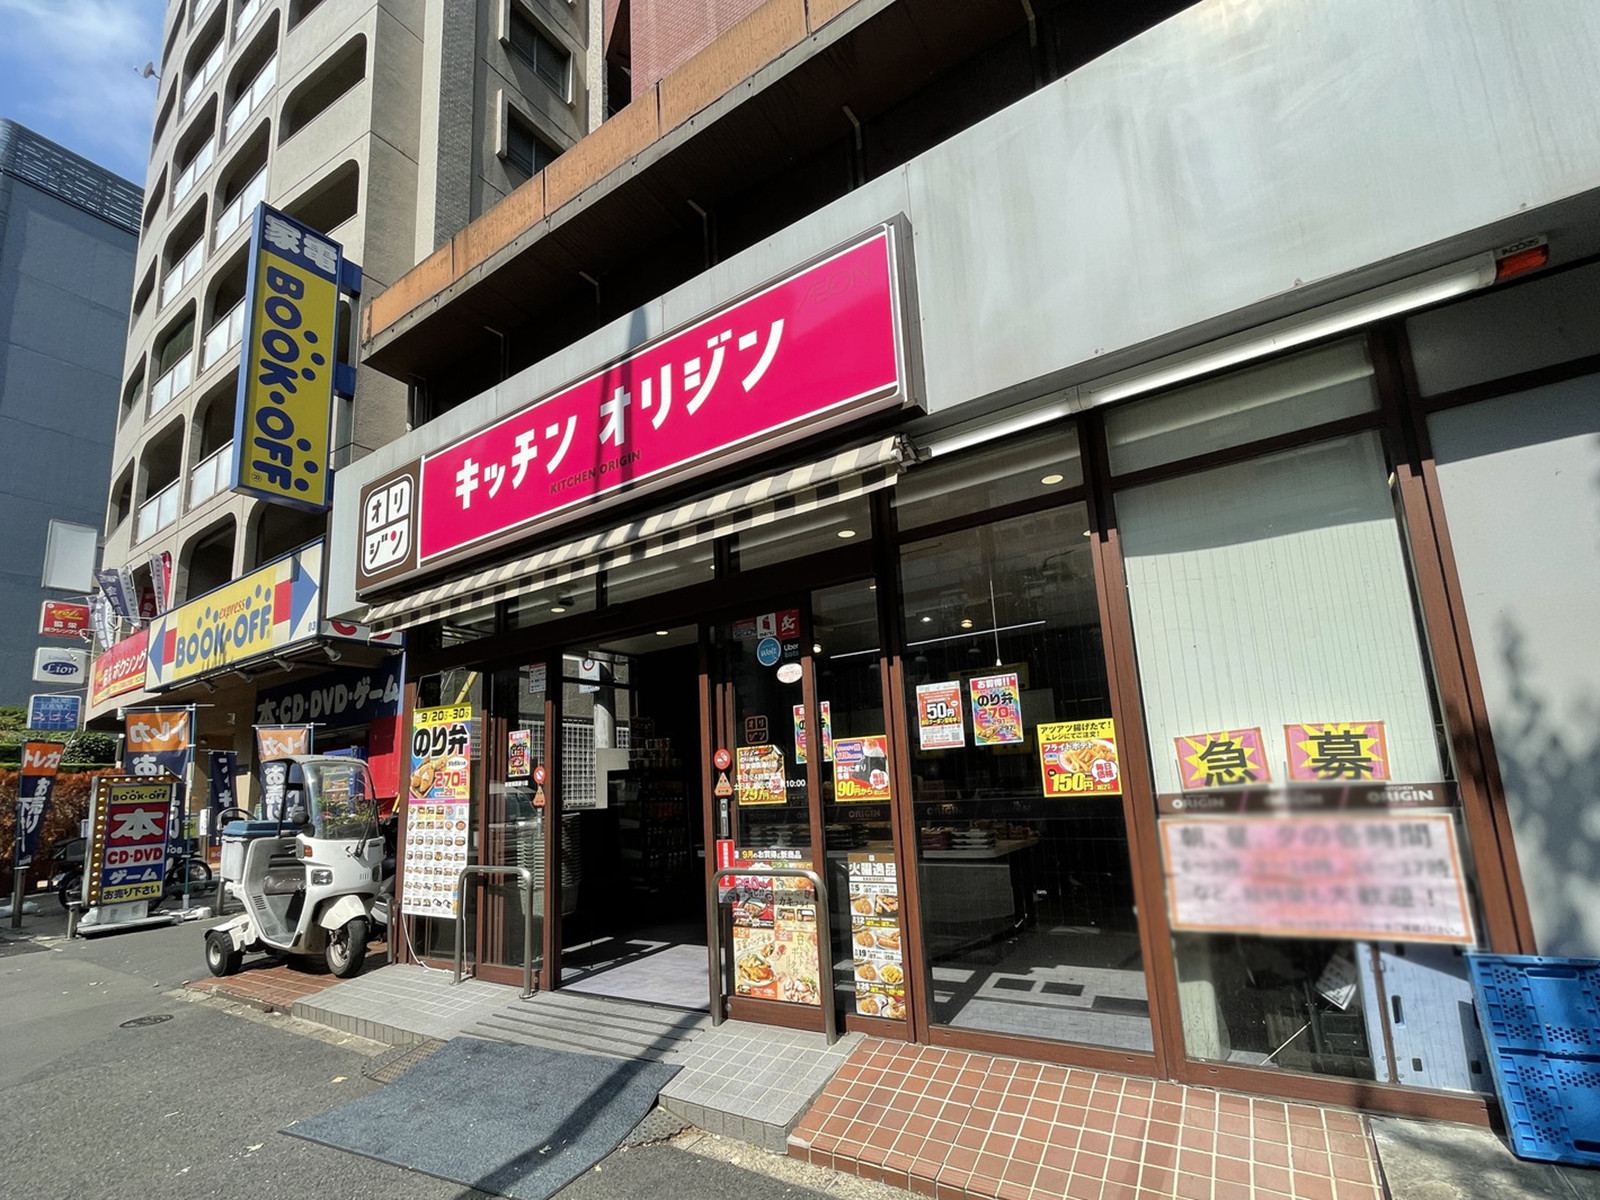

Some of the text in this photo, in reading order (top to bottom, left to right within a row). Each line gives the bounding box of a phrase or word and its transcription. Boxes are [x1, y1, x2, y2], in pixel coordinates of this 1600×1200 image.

[264, 214, 337, 275] 家電
[455, 318, 785, 510] キッチン オリジン
[550, 450, 640, 494] KITCHEN ORIGIN
[218, 598, 245, 620] express
[43, 627, 86, 637] ボクシングジ
[784, 644, 799, 652] Uber
[47, 663, 78, 675] Lion
[977, 692, 1013, 707] のり弁
[926, 702, 955, 719] 50円
[413, 724, 468, 757] のり弁
[1043, 741, 1094, 752] フライドポテト
[23, 749, 61, 768] トレカ
[1199, 740, 1257, 786] 急
[1308, 730, 1374, 780] 募
[786, 779, 806, 788] 10:00
[1051, 772, 1094, 792] 150円
[848, 809, 881, 818] ORIGIN
[110, 808, 164, 840] 本
[109, 869, 158, 884] ゲーム
[103, 885, 160, 900] お売り下さい
